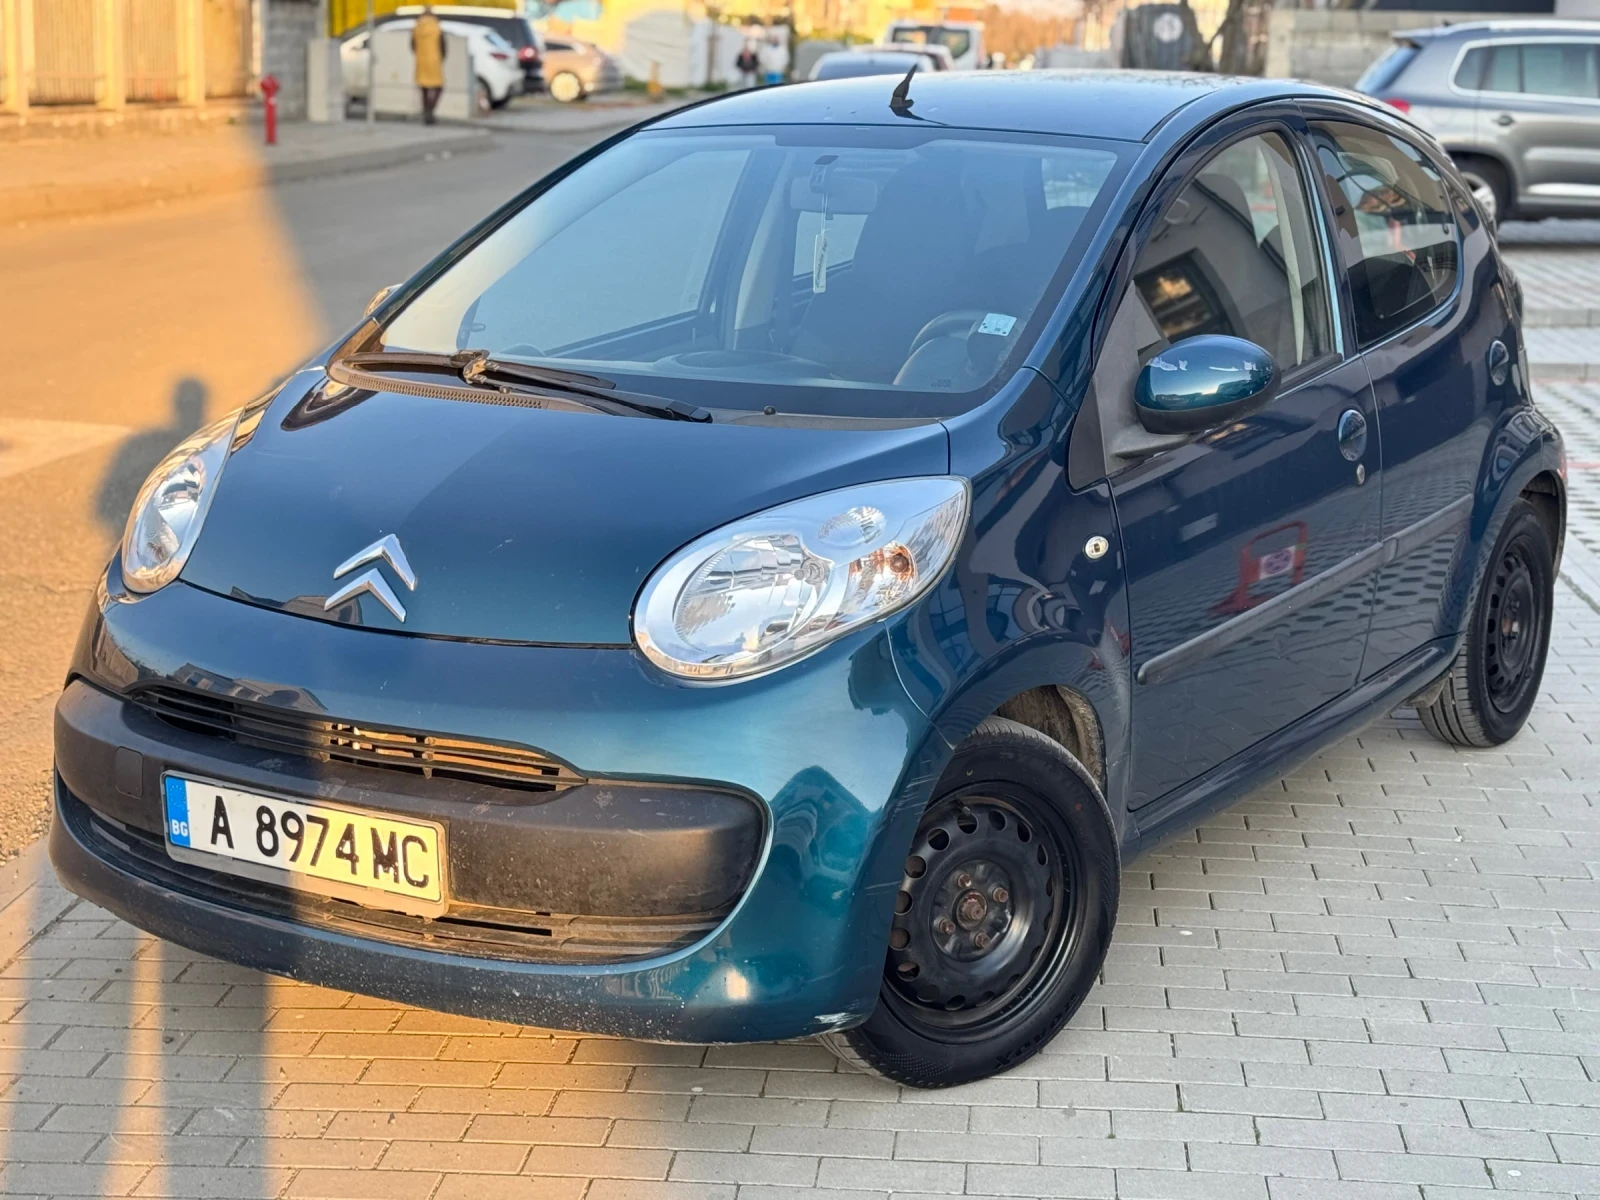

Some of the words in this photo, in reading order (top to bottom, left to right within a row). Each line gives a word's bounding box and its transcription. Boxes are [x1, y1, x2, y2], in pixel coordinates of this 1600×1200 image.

[171, 819, 189, 837] BG
[210, 795, 234, 849] A
[256, 805, 359, 875] 8974
[370, 827, 429, 888] MC
